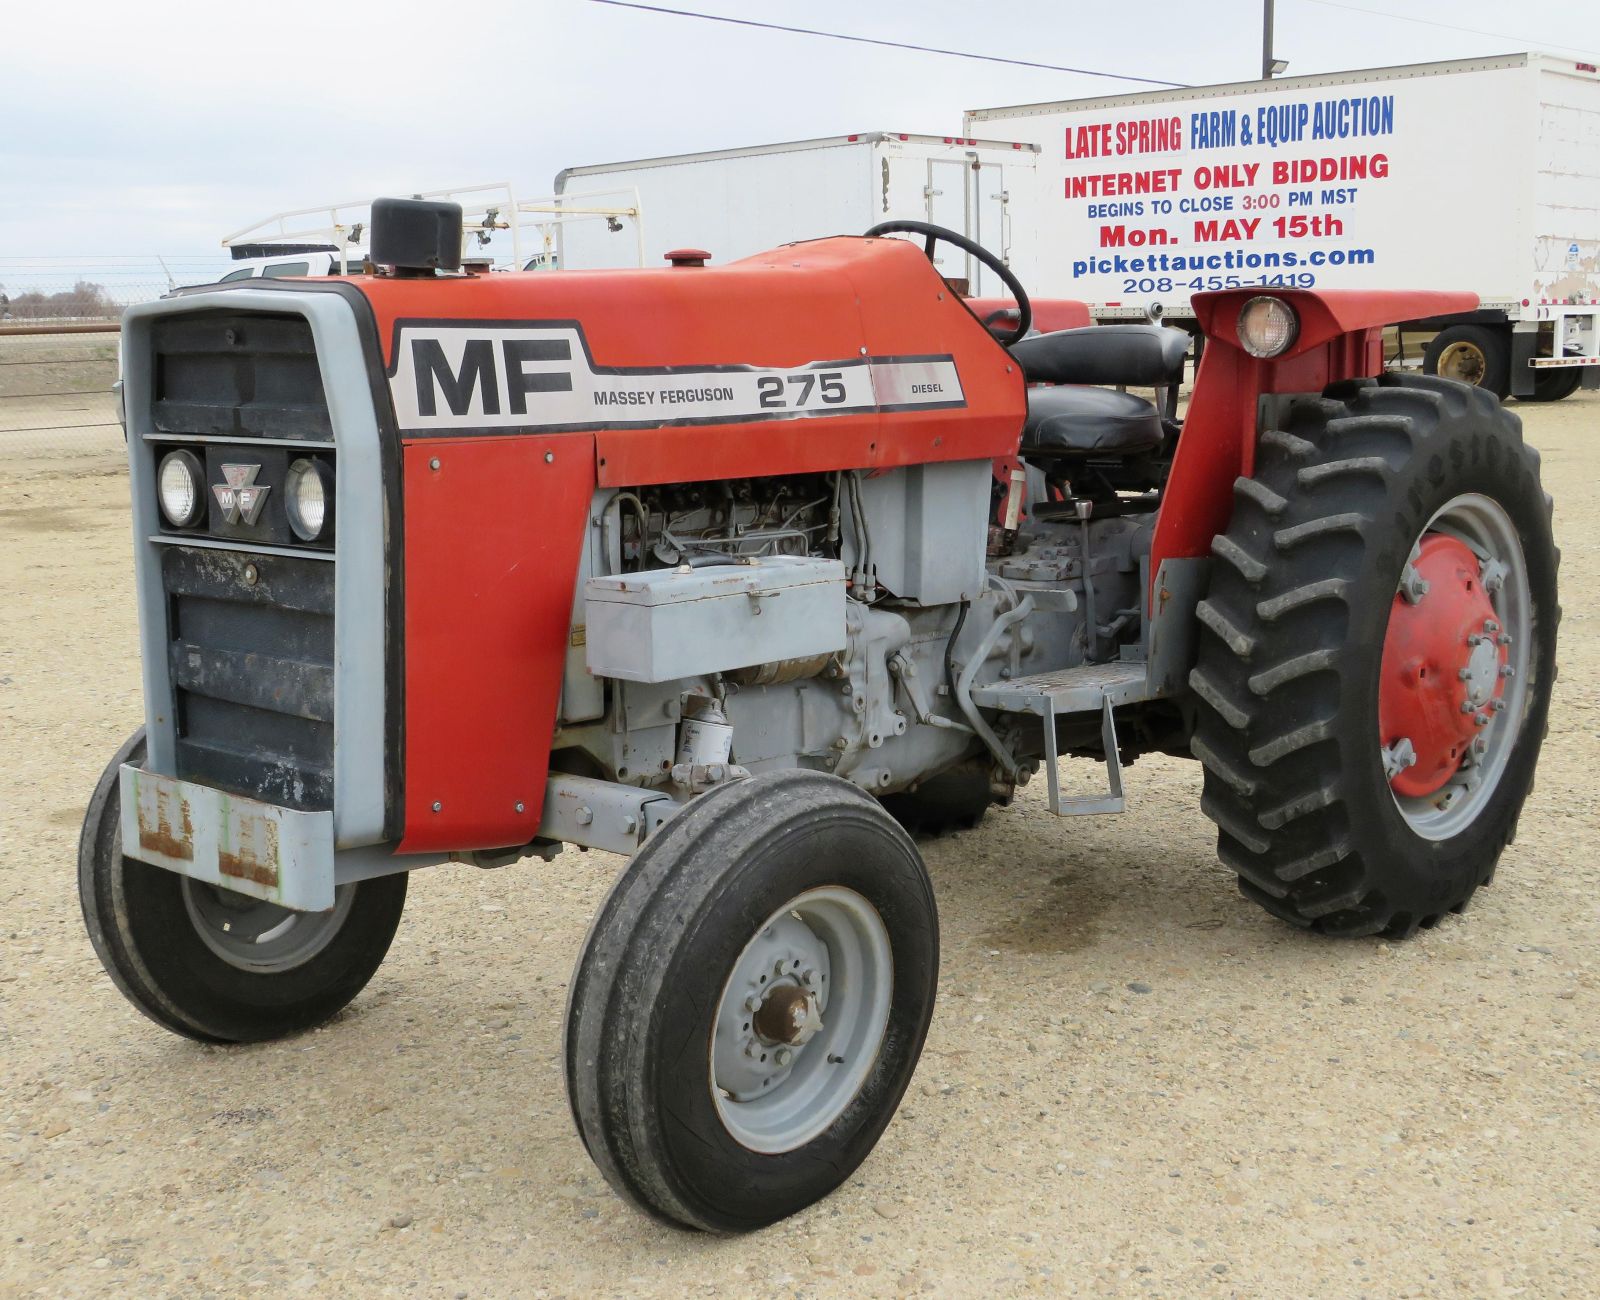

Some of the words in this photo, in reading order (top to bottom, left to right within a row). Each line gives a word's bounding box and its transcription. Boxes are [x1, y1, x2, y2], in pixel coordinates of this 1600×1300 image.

[1065, 123, 1112, 160] LATE
[1116, 116, 1182, 155] SPRING
[1191, 109, 1236, 150] FARM
[1240, 114, 1253, 146] &
[1257, 103, 1309, 148] EQUIP
[1312, 95, 1394, 140] AUCTION
[1064, 169, 1183, 199] INTERNET
[1194, 163, 1260, 190] ONLY
[1272, 153, 1389, 185] BIDDING
[1088, 202, 1144, 219] BEGINS
[1151, 199, 1172, 215] TO
[1179, 196, 1234, 213] CLOSE
[1242, 193, 1280, 210] 3:00
[1288, 190, 1313, 207] PM
[1321, 188, 1358, 205] MST
[1100, 225, 1179, 248] Mon.
[1194, 217, 1262, 242] MAY
[1272, 214, 1343, 239] 15th
[1073, 249, 1375, 278] pickettauctions.com
[1123, 273, 1316, 293] 208-455-1419
[411, 338, 573, 417] MF
[593, 389, 656, 405] MASSEY
[659, 387, 734, 404] FERGUSON
[757, 373, 847, 408] 275
[911, 383, 944, 395] DIESEL
